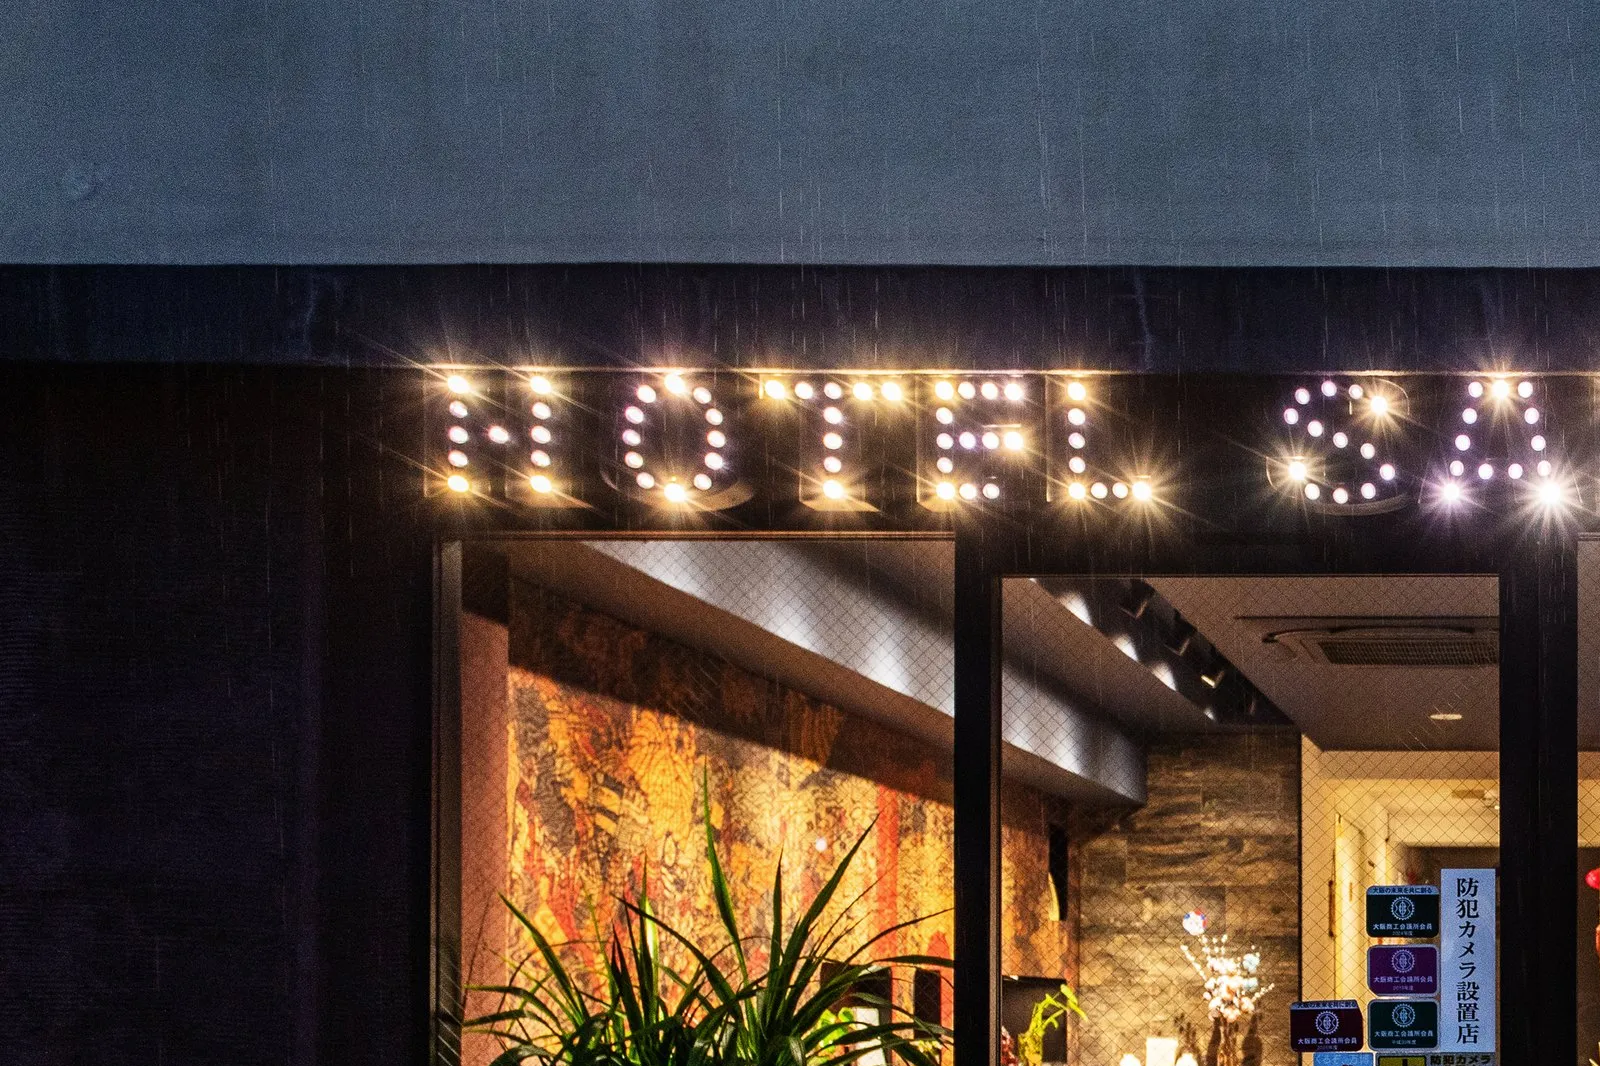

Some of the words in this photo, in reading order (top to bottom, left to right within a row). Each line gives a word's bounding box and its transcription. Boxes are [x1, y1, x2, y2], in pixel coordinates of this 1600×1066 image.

[424, 366, 1162, 508] HOTEL
[1456, 877, 1480, 1045] 防犯カメラ設置店
[1430, 1055, 1491, 1065] 防犯カメラ
